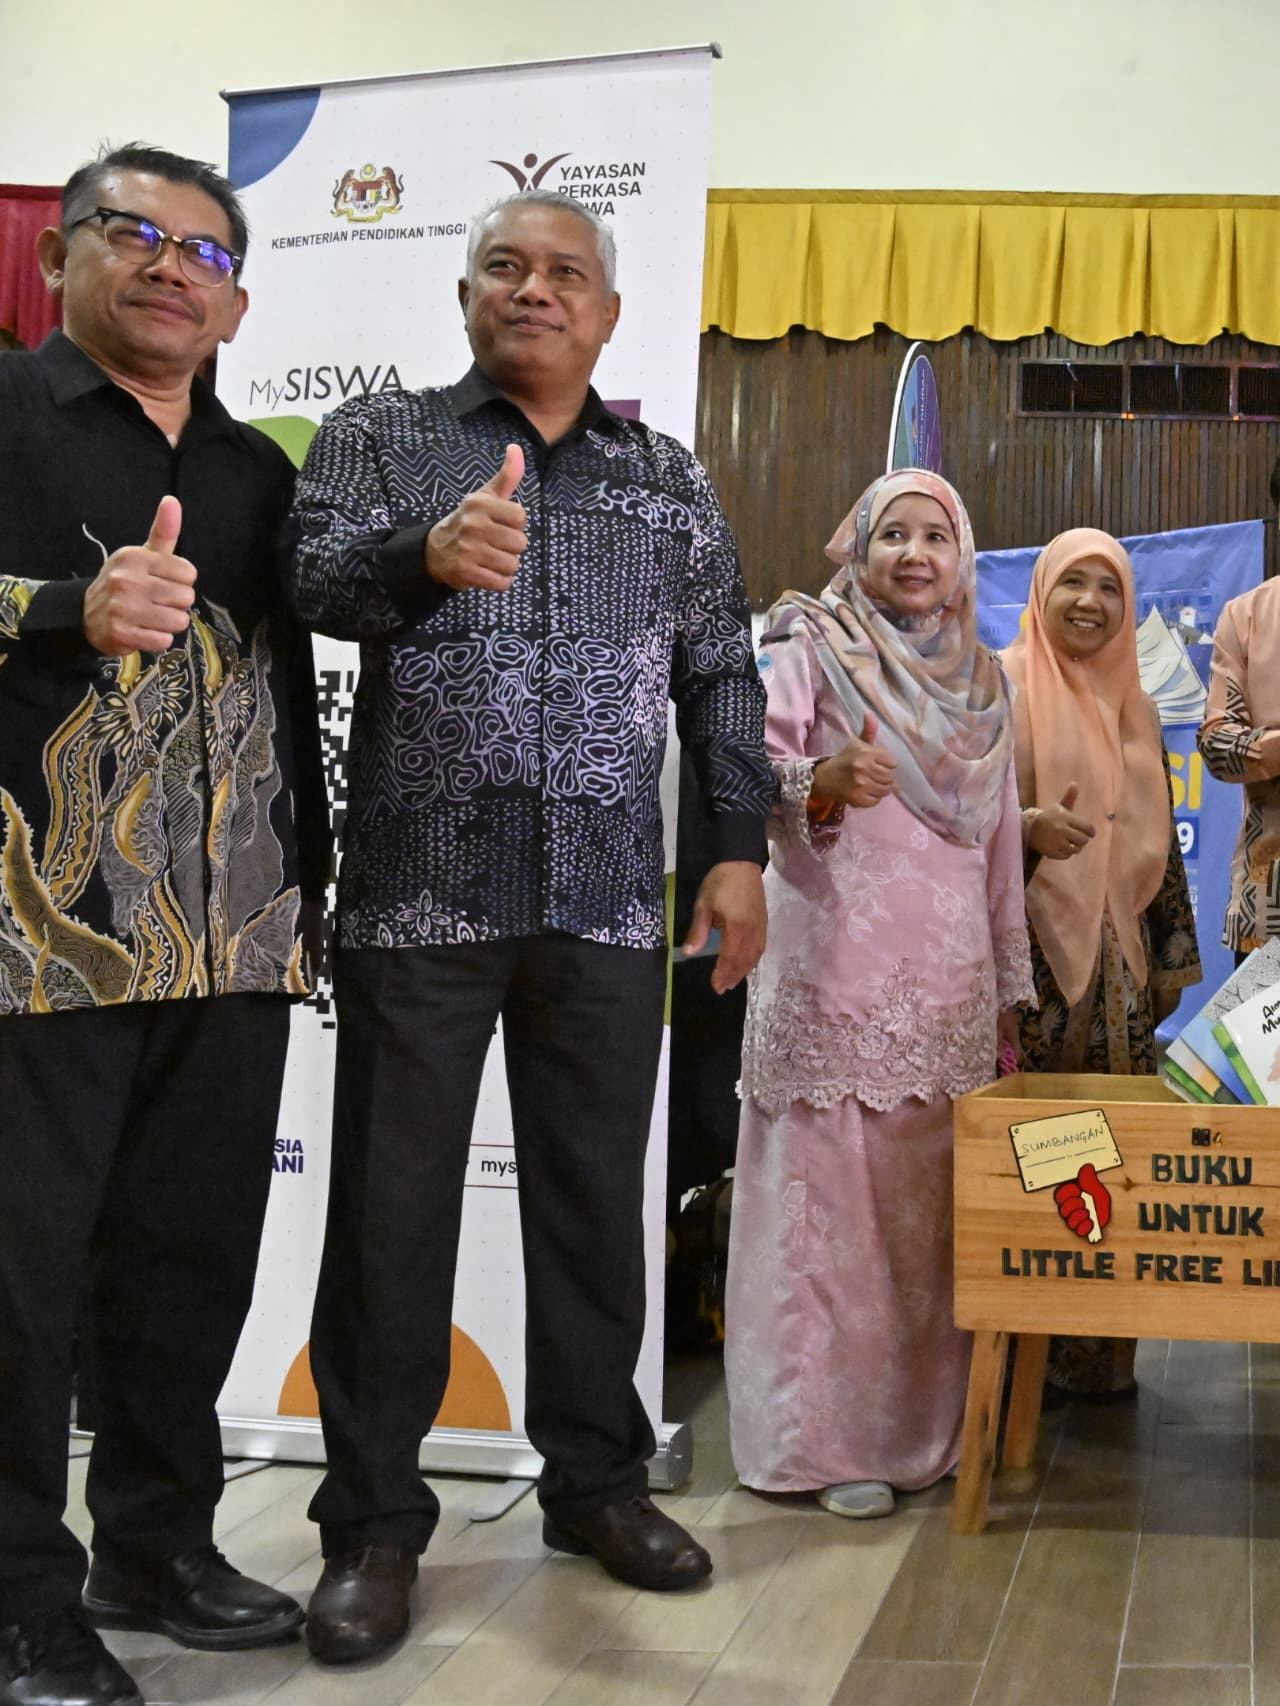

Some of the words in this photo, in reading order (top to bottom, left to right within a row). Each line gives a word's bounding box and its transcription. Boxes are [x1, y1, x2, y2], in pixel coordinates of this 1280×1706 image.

[560, 162, 645, 181] YAYASAN
[558, 181, 642, 199] PERKASA
[271, 230, 348, 249] KEMENTERIAN
[351, 226, 424, 241] PENDIDIKAN
[427, 223, 467, 238] TINGGI
[1021, 1125, 1105, 1153] SUMBANGAN
[1152, 1153, 1252, 1186] BUKU
[1138, 1202, 1264, 1237] UNTUK
[1002, 1247, 1115, 1280] LITTLE
[1135, 1253, 1223, 1284] FREE
